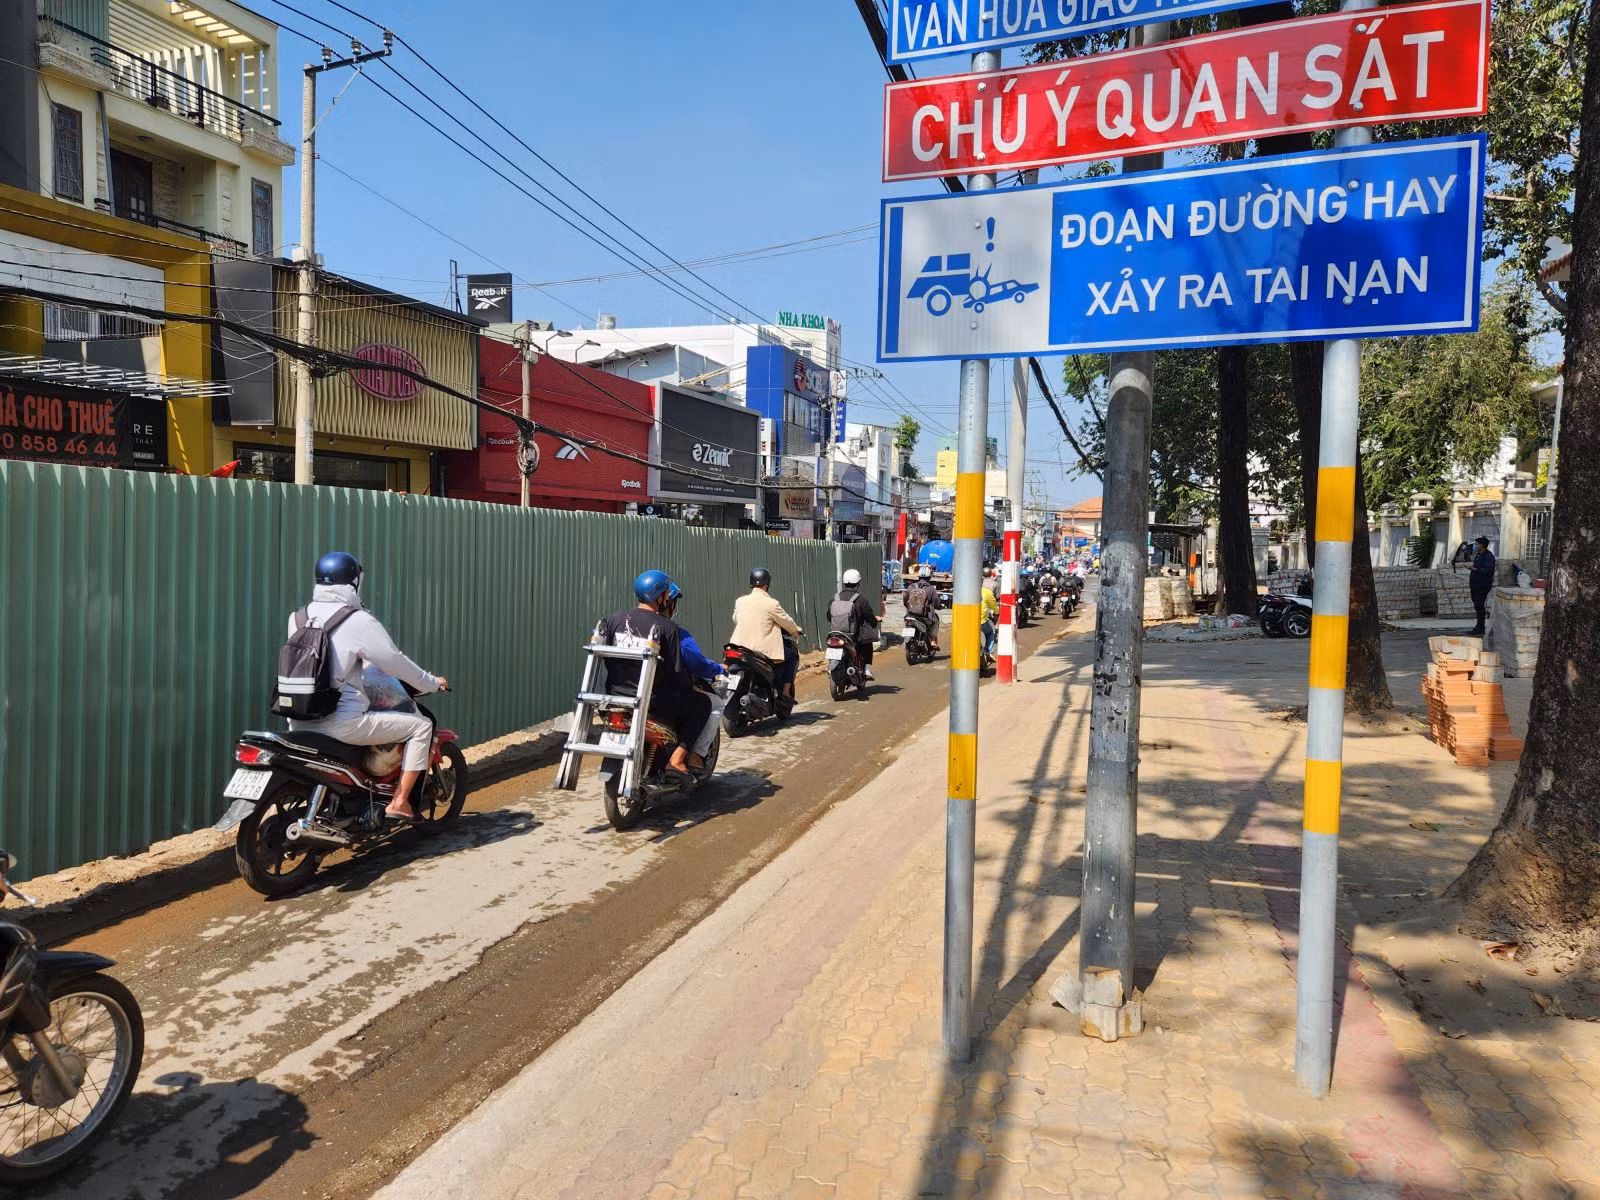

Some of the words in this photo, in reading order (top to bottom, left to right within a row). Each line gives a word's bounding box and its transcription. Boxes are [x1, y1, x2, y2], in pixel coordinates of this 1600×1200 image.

[912, 78, 1027, 162] CHÚ
[1046, 70, 1080, 147] Ý
[1096, 52, 1279, 140] QUAN
[1302, 18, 1445, 110] SÁT
[1060, 204, 1175, 252] ĐOẠN
[1188, 183, 1348, 237] ĐƯỜNG
[1363, 174, 1458, 220] HAY
[1086, 267, 1166, 316] XẢY
[1178, 272, 1233, 310] RA
[1246, 264, 1309, 304] TAI
[1326, 255, 1429, 305] NẠN
[779, 311, 799, 328] NHA
[801, 313, 826, 331] KHOA
[23, 394, 63, 432] CHO
[68, 398, 116, 436] THUÊ
[21, 434, 58, 453] 858
[64, 437, 88, 455] 46
[93, 441, 118, 457] 44
[702, 443, 734, 468] Zennic
